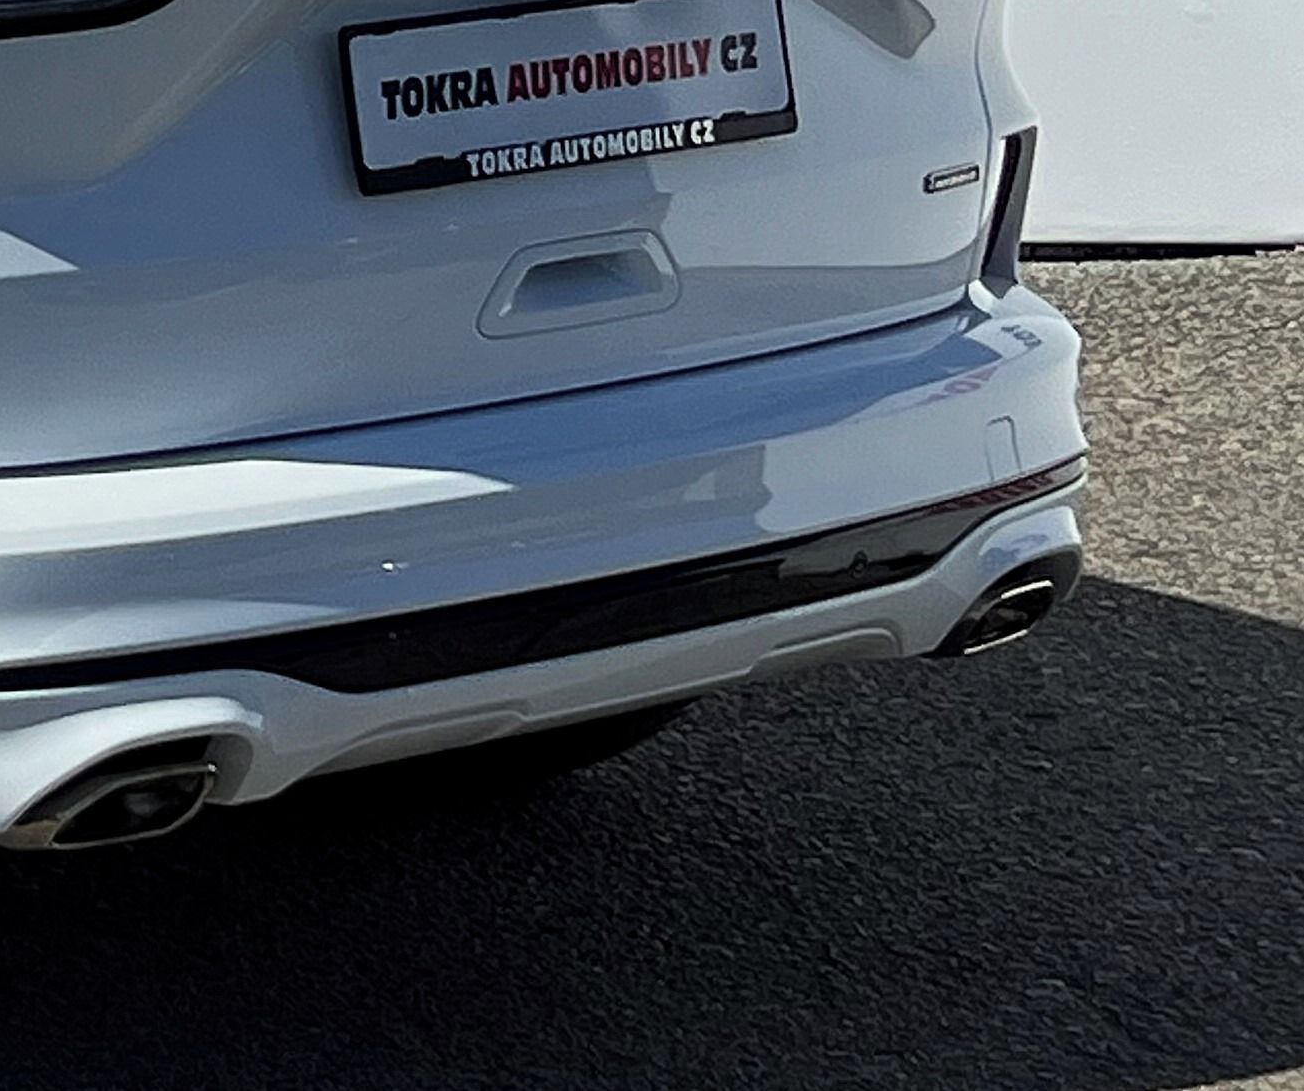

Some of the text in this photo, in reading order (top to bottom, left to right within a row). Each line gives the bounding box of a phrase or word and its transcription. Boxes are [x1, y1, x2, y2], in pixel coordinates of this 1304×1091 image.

[381, 32, 758, 120] TOKRA AUTOMOBILY CZ
[465, 118, 716, 177] TOKRA AUTOMOBILY CZ
